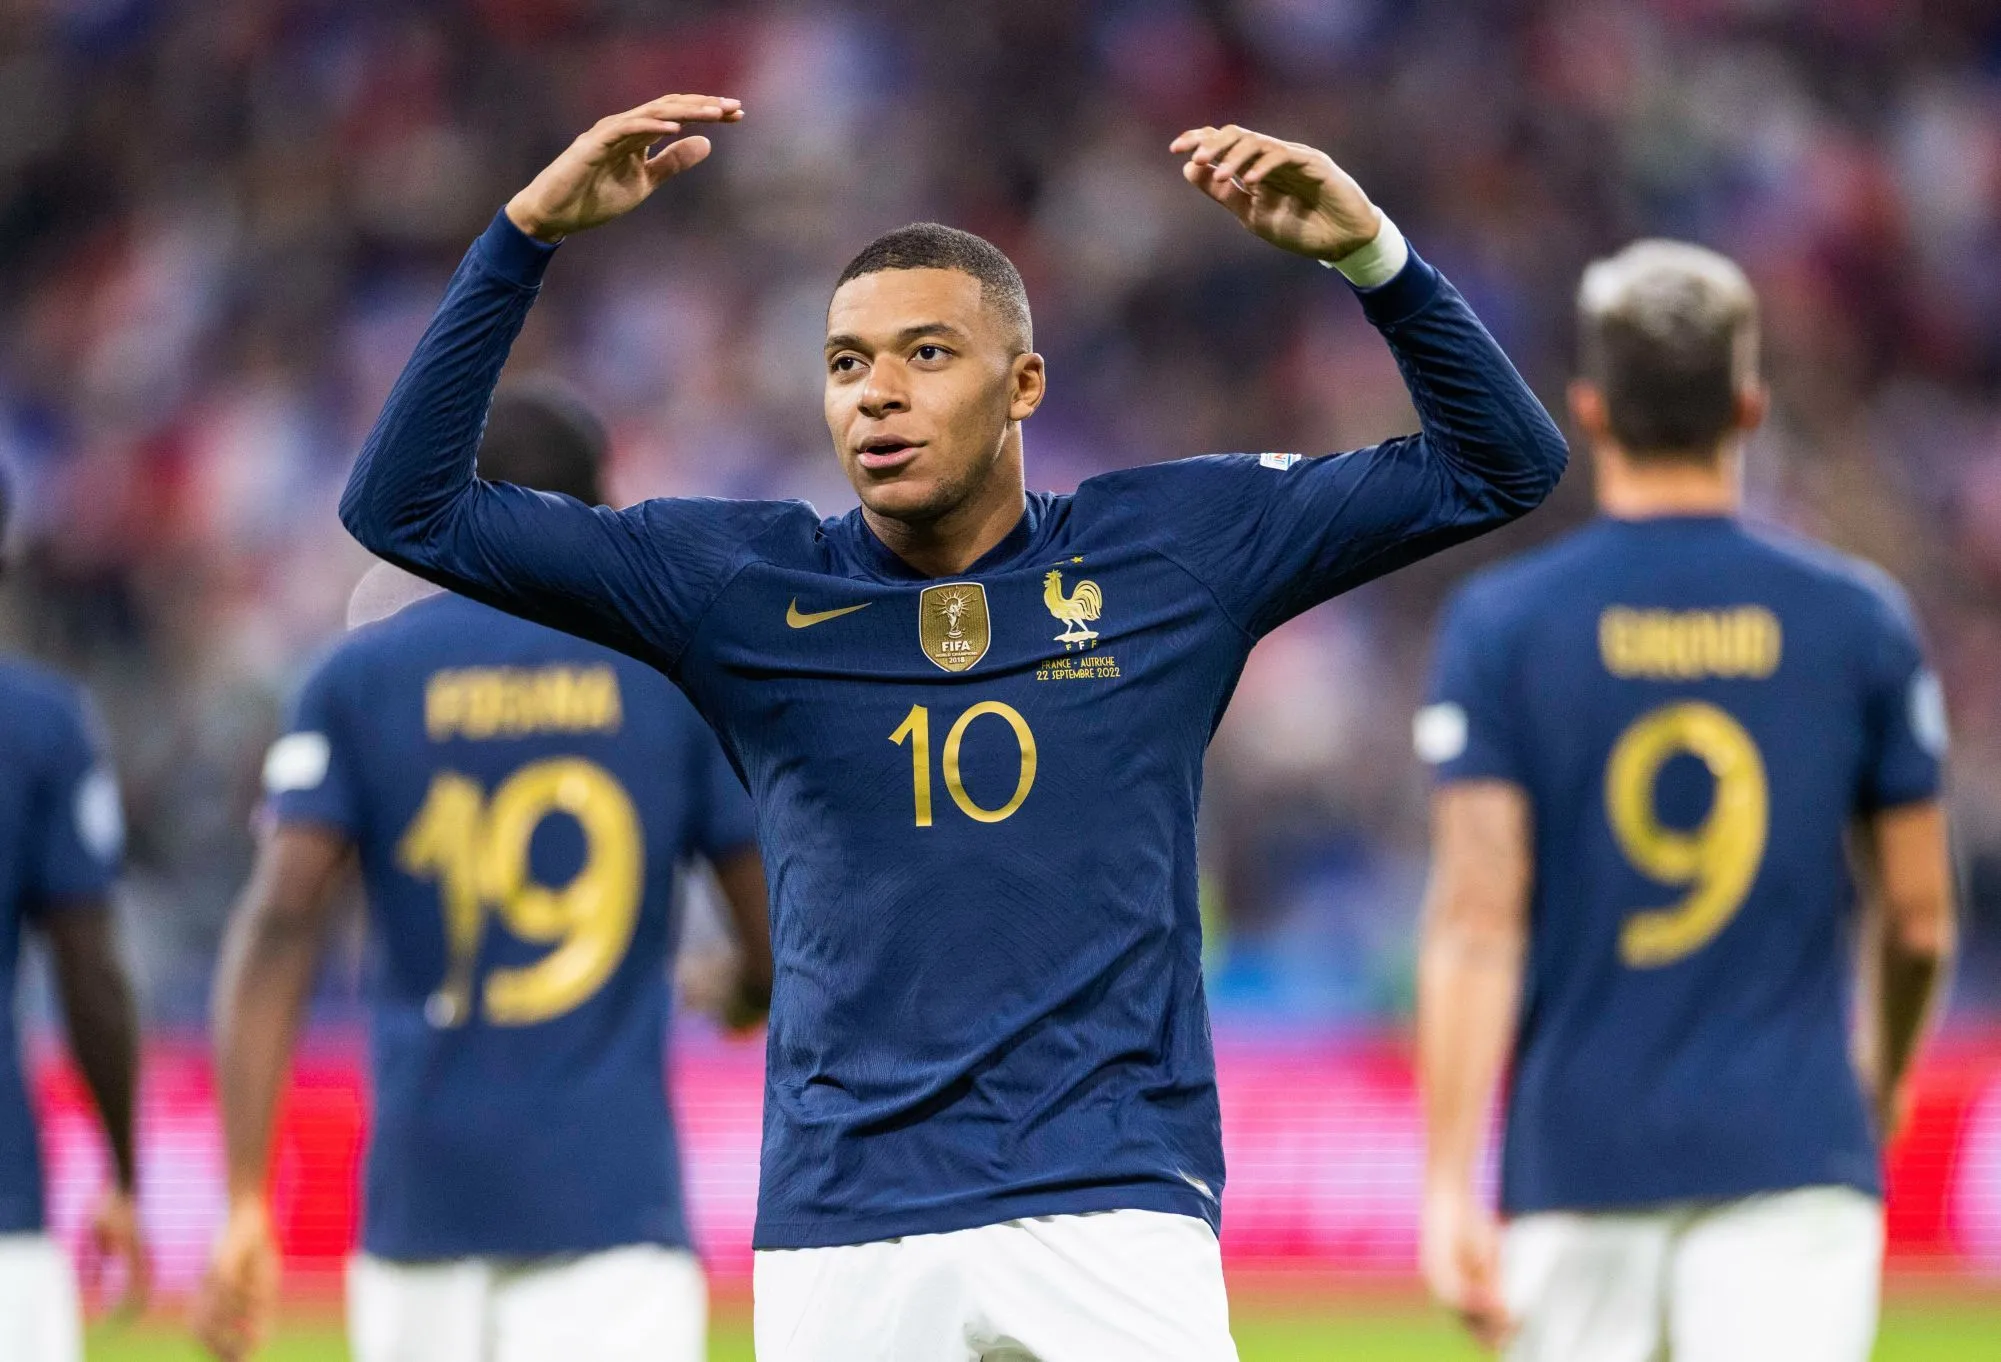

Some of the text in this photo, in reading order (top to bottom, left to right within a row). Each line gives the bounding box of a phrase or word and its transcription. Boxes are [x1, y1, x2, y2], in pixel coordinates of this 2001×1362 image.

[942, 640, 970, 652] FIFA
[948, 656, 965, 664] 2018
[1041, 658, 1072, 670] FRANCE
[1080, 656, 1115, 668] AUTRICHE
[1036, 667, 1121, 681] 22 SEPTEMBRE 2022
[887, 700, 1038, 827] 10
[1605, 702, 1768, 968] 9
[397, 755, 646, 1027] 19
